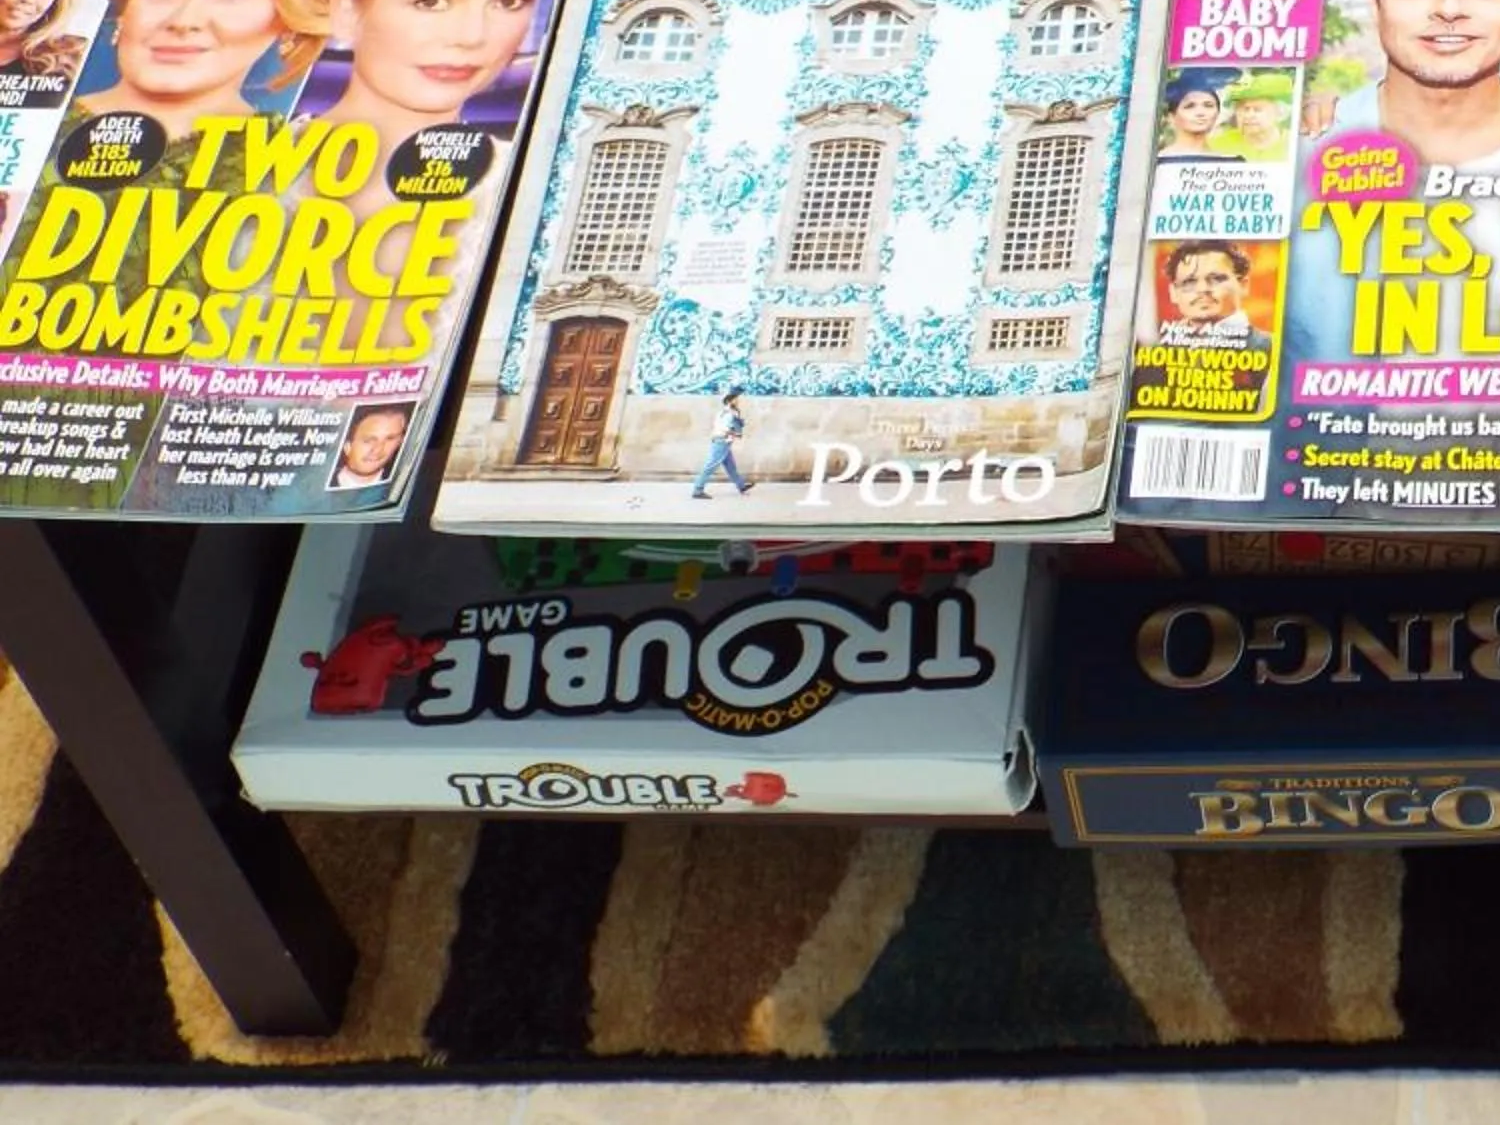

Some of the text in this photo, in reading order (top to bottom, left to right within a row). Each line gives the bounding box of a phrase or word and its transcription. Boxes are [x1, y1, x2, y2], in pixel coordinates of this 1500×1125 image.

[1181, 26, 1308, 59] BOOM!
[97, 116, 144, 131] ADELE
[90, 129, 143, 143] WORTH
[416, 131, 483, 147] MICHELLE
[187, 115, 379, 198] TWO
[420, 146, 471, 161] WORTH
[1322, 146, 1399, 170] Going
[67, 161, 141, 177] MILLION
[1321, 163, 1405, 195] Public!
[395, 176, 467, 195] MILLION
[1168, 194, 1274, 213] WAR OVER
[1155, 215, 1283, 235] ROYAL BABY!
[17, 186, 475, 298] DIVORCE
[0, 281, 441, 365] BOMBSHELLS
[1352, 277, 1441, 356] IN
[1137, 347, 1268, 370] HOLLYWOOD
[72, 363, 422, 400] Details: Why Both Marriages Failed
[1166, 367, 1234, 389] TURNS
[1301, 368, 1450, 398] ROMANTIC
[3, 397, 143, 420] made career out
[1173, 388, 1259, 411] JOHNNY
[170, 404, 344, 427] First Michelle Williams
[1368, 413, 1447, 439] brought
[1450, 418, 1474, 436] us
[61, 423, 109, 444] songs
[161, 423, 339, 450] lost Heath Ledger. Now
[21, 440, 130, 461] had heart
[159, 446, 310, 468] her marriage over
[1304, 447, 1376, 469] Secret
[1378, 450, 1417, 474] stay
[74, 465, 117, 483] again
[177, 467, 245, 486] less than
[797, 441, 1055, 509] Porto
[1301, 481, 1349, 504] They
[1353, 480, 1390, 502] left
[1393, 481, 1496, 506] MINUTES
[459, 602, 566, 635] GAME
[417, 597, 994, 717] TROUBLE
[686, 679, 833, 732] POP-O-MATIC
[450, 772, 722, 807] TROUBLE
[1270, 775, 1415, 791] TRADITIONS
